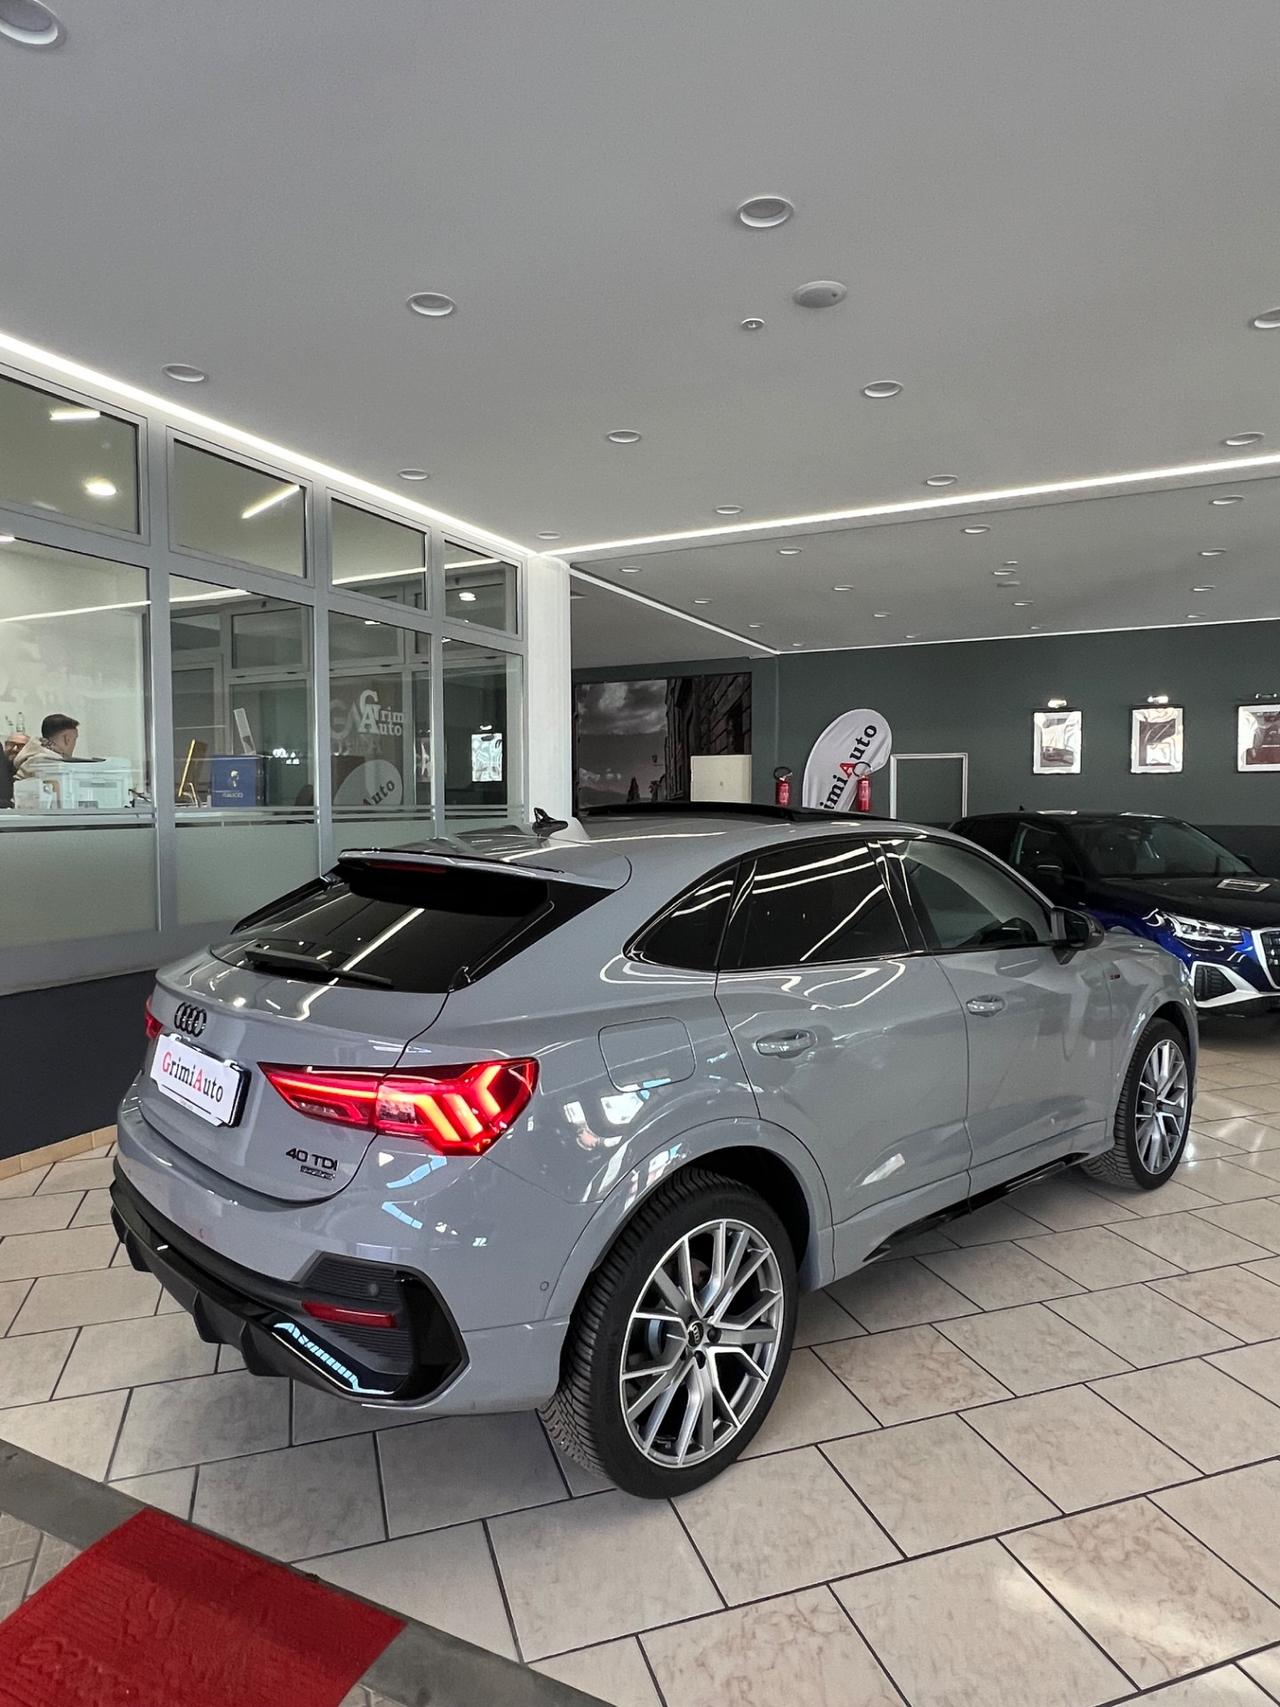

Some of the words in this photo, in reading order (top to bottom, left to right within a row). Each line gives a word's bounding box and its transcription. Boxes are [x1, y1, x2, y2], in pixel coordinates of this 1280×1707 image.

[359, 689, 405, 723] Grim
[820, 725, 877, 809] imiAuto
[162, 1051, 224, 1103] GrimiAuto
[285, 1147, 309, 1163] 40
[311, 1153, 338, 1171] TDI
